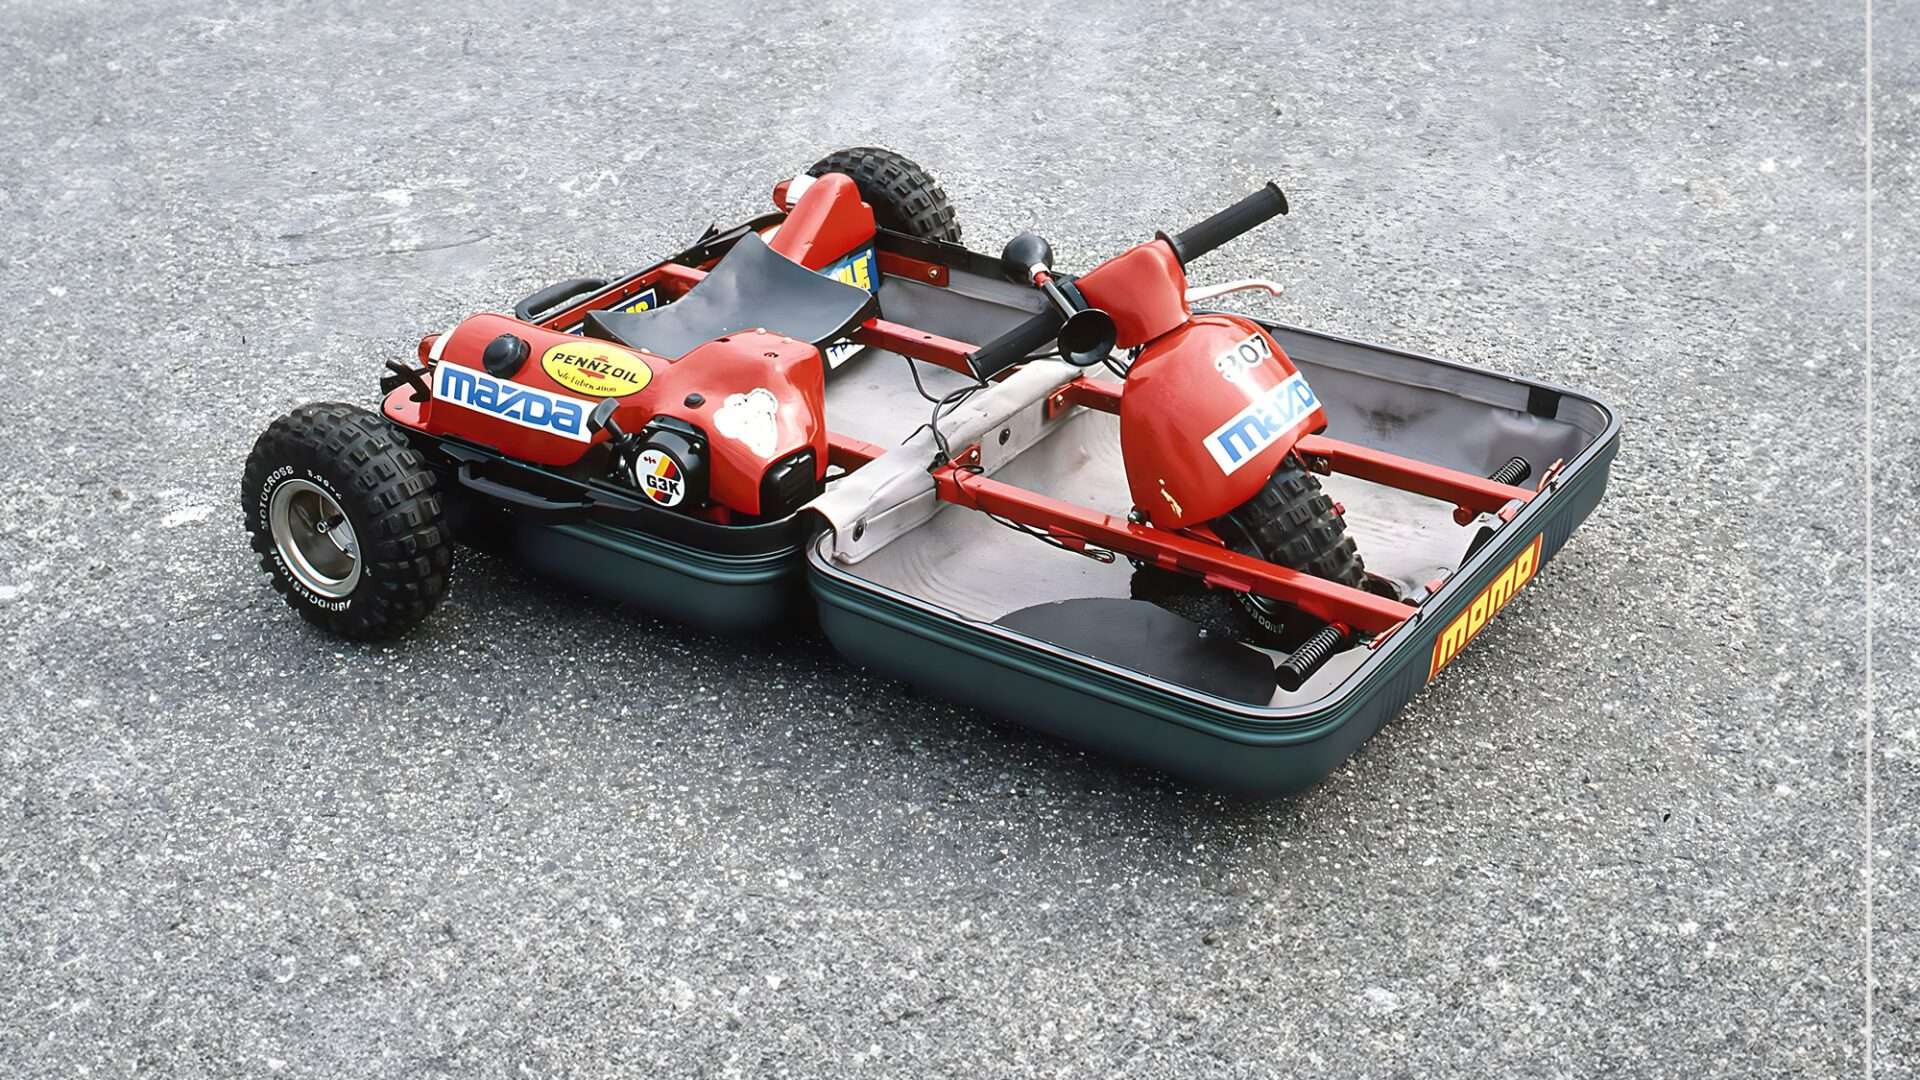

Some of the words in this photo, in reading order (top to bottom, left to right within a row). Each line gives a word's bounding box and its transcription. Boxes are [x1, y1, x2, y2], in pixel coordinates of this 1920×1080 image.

[552, 352, 639, 384] PENNZOIL
[260, 465, 294, 530] MOTOCROSS
[646, 474, 680, 496] G3K
[1438, 543, 1535, 669] momo
